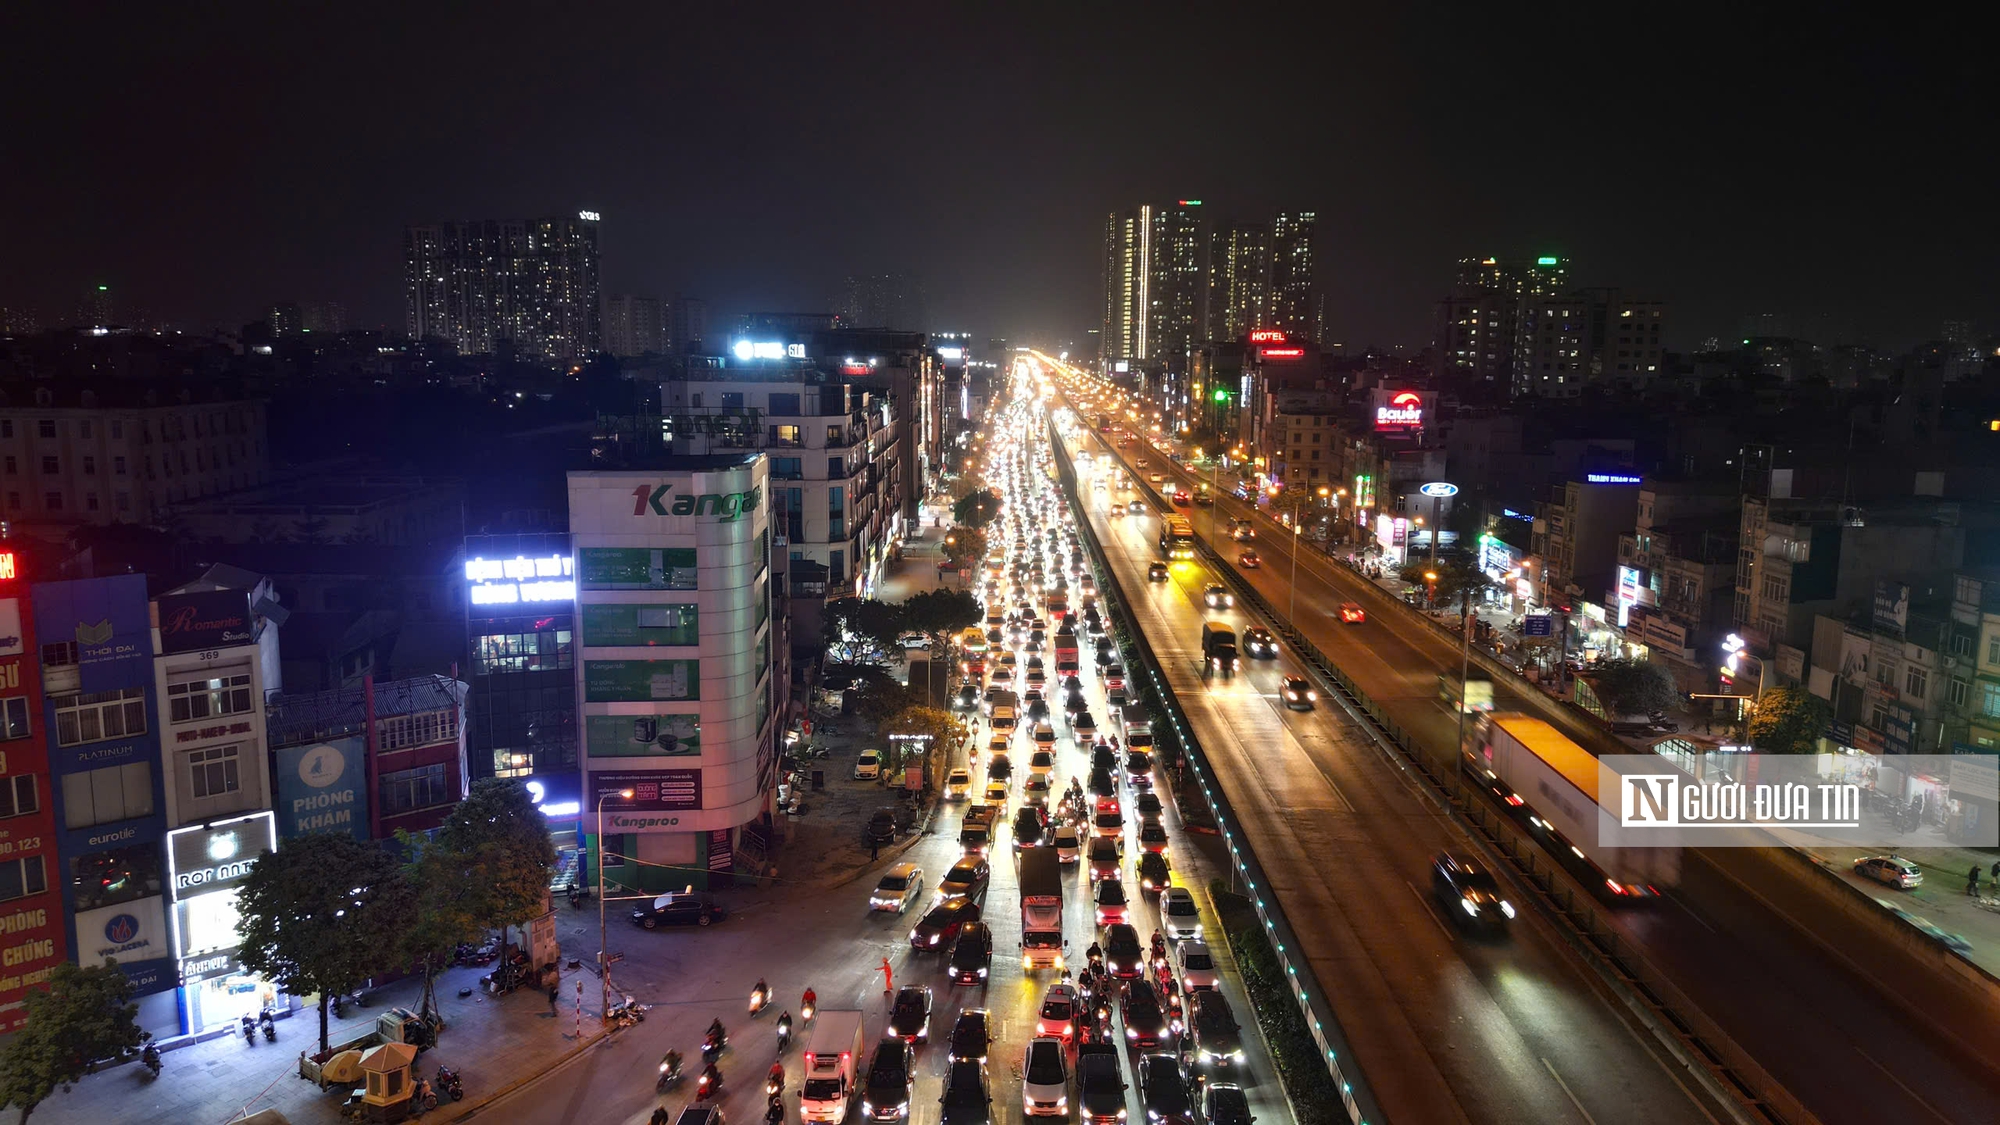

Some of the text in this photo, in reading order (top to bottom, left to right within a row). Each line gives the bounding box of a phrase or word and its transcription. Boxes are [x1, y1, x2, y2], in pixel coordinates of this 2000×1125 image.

[1252, 332, 1285, 341] HOTEL
[222, 631, 250, 641] Studio
[199, 650, 219, 660] 369
[79, 745, 133, 761] PLATINUM
[293, 789, 355, 813] PHÒNG
[298, 809, 351, 832] KHÁM
[607, 815, 679, 829] Kangaroo
[88, 829, 135, 846] eurotile
[0, 908, 46, 935] PHÒNG
[3, 938, 54, 967] CHỨNG
